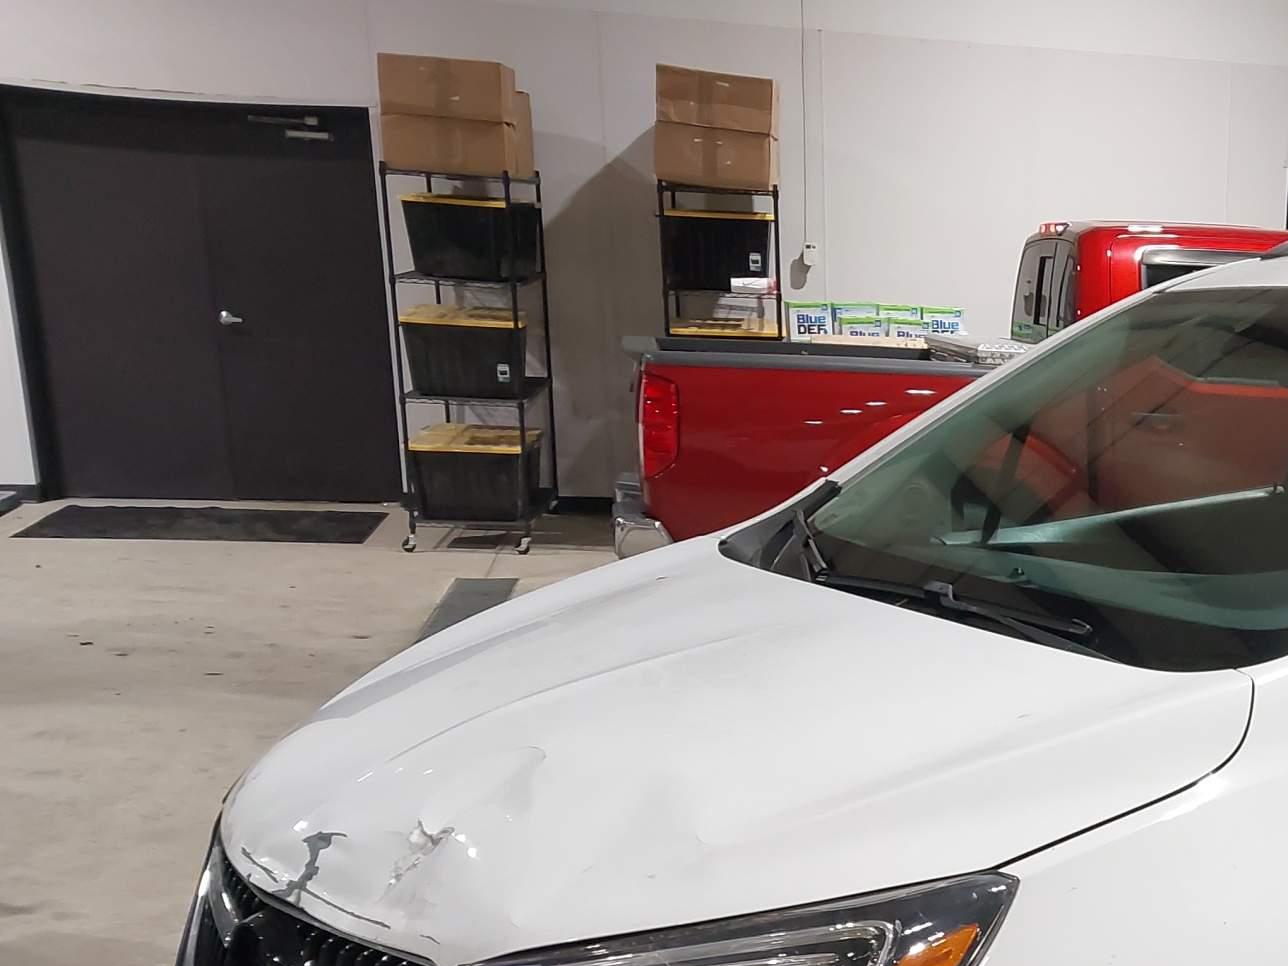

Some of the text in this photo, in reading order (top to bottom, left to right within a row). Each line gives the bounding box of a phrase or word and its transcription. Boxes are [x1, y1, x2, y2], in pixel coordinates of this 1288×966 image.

[797, 314, 826, 324] Blue
[931, 319, 960, 330] Blue
[797, 324, 827, 335] DEF
